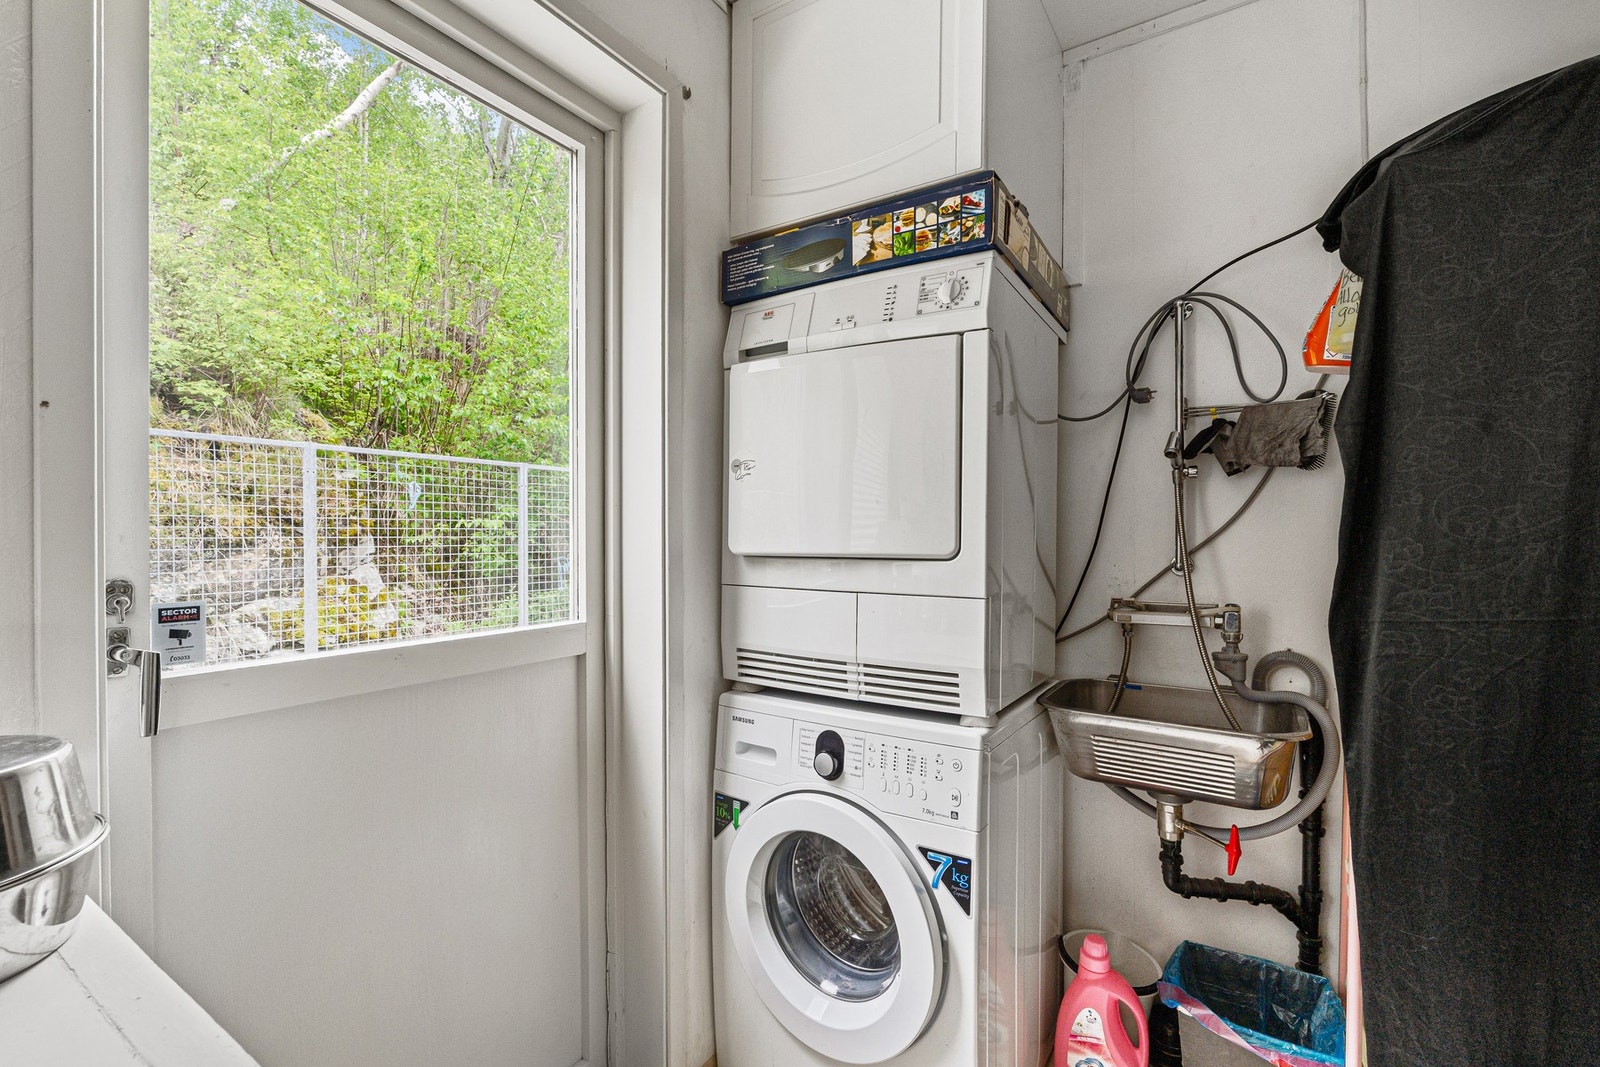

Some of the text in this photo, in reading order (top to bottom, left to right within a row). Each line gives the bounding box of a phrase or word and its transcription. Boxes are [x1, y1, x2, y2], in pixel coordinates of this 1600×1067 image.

[161, 608, 198, 616] SECTOR
[732, 715, 755, 725] SAMSUNG
[716, 806, 731, 820] 10%
[927, 851, 969, 889] 7 kg
